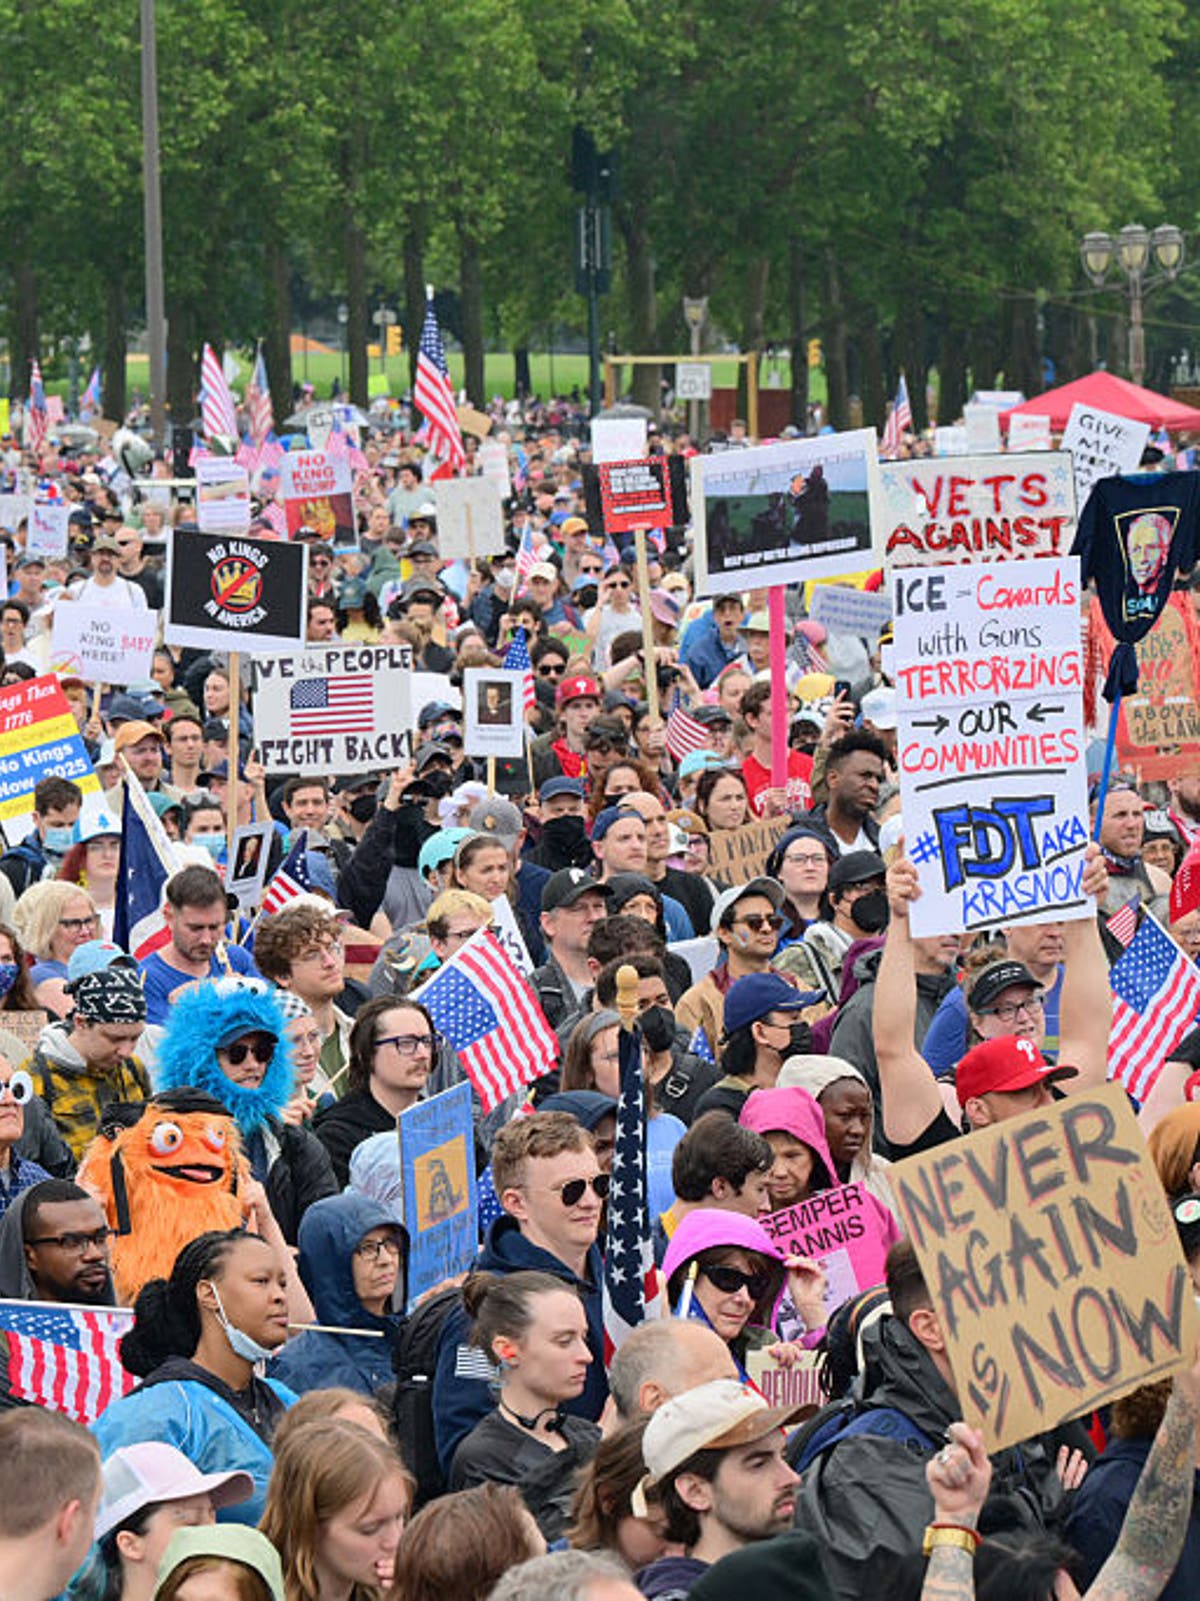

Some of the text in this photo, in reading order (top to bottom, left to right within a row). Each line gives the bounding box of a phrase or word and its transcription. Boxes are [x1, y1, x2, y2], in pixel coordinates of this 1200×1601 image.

[292, 466, 334, 480] KING
[298, 454, 326, 468] NO
[911, 473, 1049, 520] VETS
[206, 541, 270, 569] NO KINGS
[885, 517, 1070, 556] AGAINST
[895, 576, 947, 617] ICE
[976, 569, 1077, 612] Cowards
[90, 620, 111, 634] NO
[216, 606, 269, 628] AMERICA
[79, 633, 115, 648] KING
[918, 618, 1042, 657] with Guns
[325, 647, 412, 672] PEOPLE
[3, 709, 35, 732] 1776
[958, 702, 1018, 738] OUR
[21, 743, 74, 768] Kings
[260, 729, 414, 766] FIGHT BACK!
[901, 728, 1080, 774] COMMUNITIES
[1041, 814, 1088, 858] AKA
[961, 860, 1085, 925] KRASNOV
[899, 1103, 1141, 1249] NEVER
[759, 1184, 864, 1241] SEMPER
[936, 1177, 1139, 1341] AGAIN
[966, 1263, 1186, 1418] IS NOW
